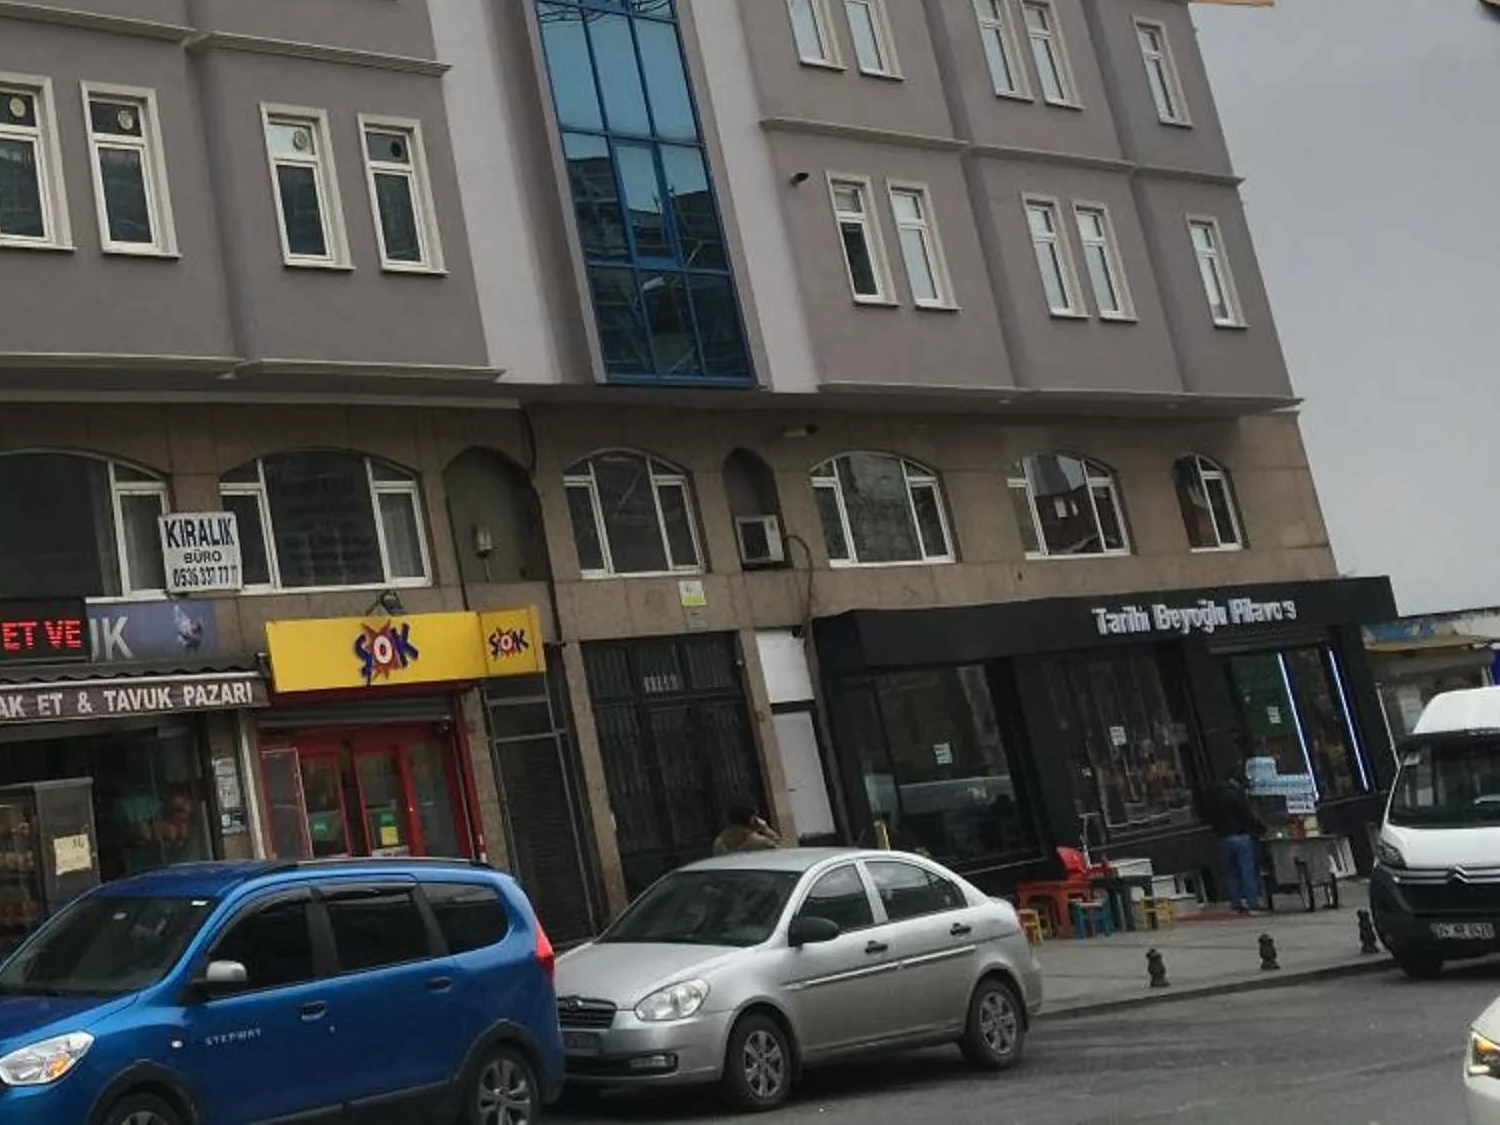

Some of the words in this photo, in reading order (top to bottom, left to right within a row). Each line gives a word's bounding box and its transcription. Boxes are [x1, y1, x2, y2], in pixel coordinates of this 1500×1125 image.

[164, 518, 235, 548] KIRALIK
[184, 549, 223, 564] BÜRO
[3, 620, 37, 650] ET
[44, 619, 82, 649] VE
[355, 622, 419, 686] ŞOK
[37, 692, 64, 715] ET
[77, 691, 92, 713] &
[104, 686, 173, 712] TAVUK
[183, 682, 253, 706] PAZARI
